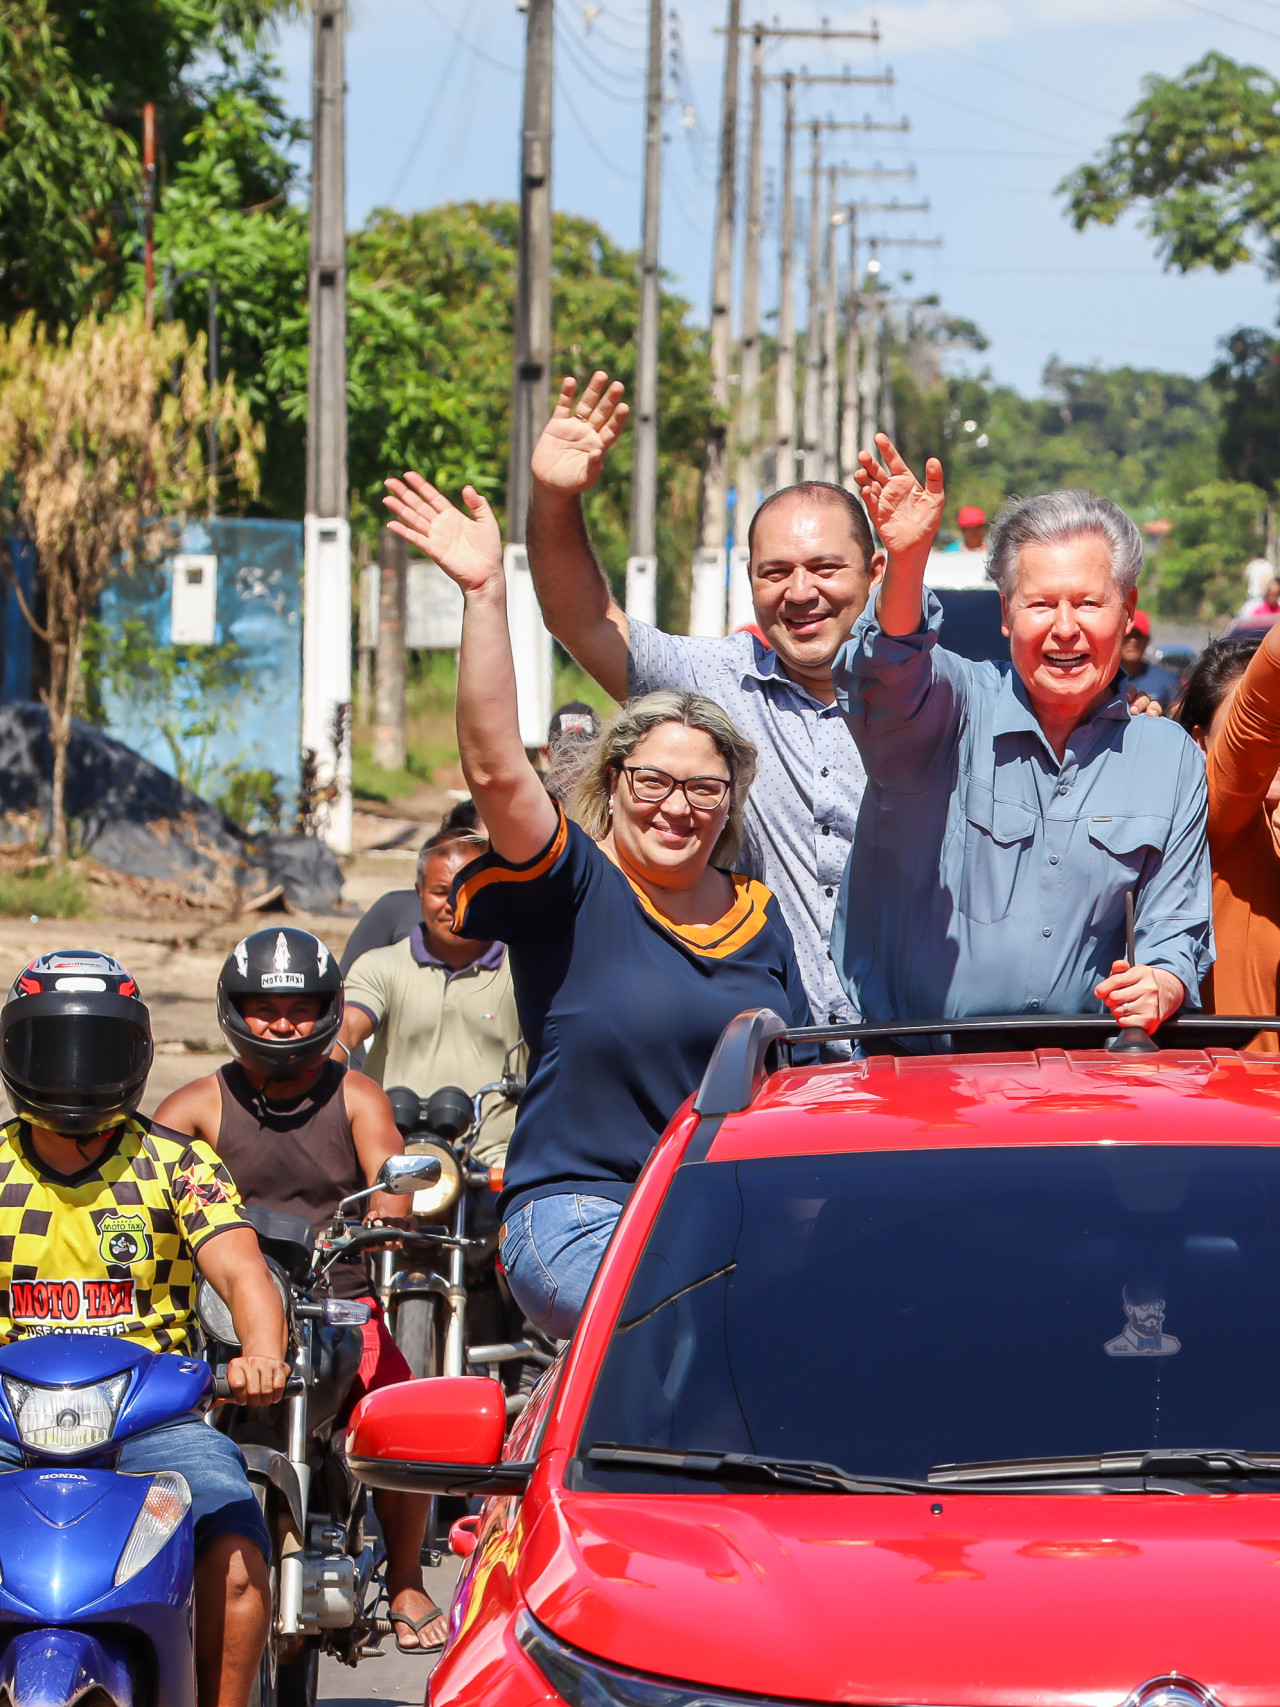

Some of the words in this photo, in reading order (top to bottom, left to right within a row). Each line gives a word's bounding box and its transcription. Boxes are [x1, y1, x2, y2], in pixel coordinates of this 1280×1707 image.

[285, 974, 303, 984] TAXI
[11, 1281, 80, 1320] MOTO
[82, 1280, 135, 1319] TAXI
[39, 1473, 88, 1481] HONDA
